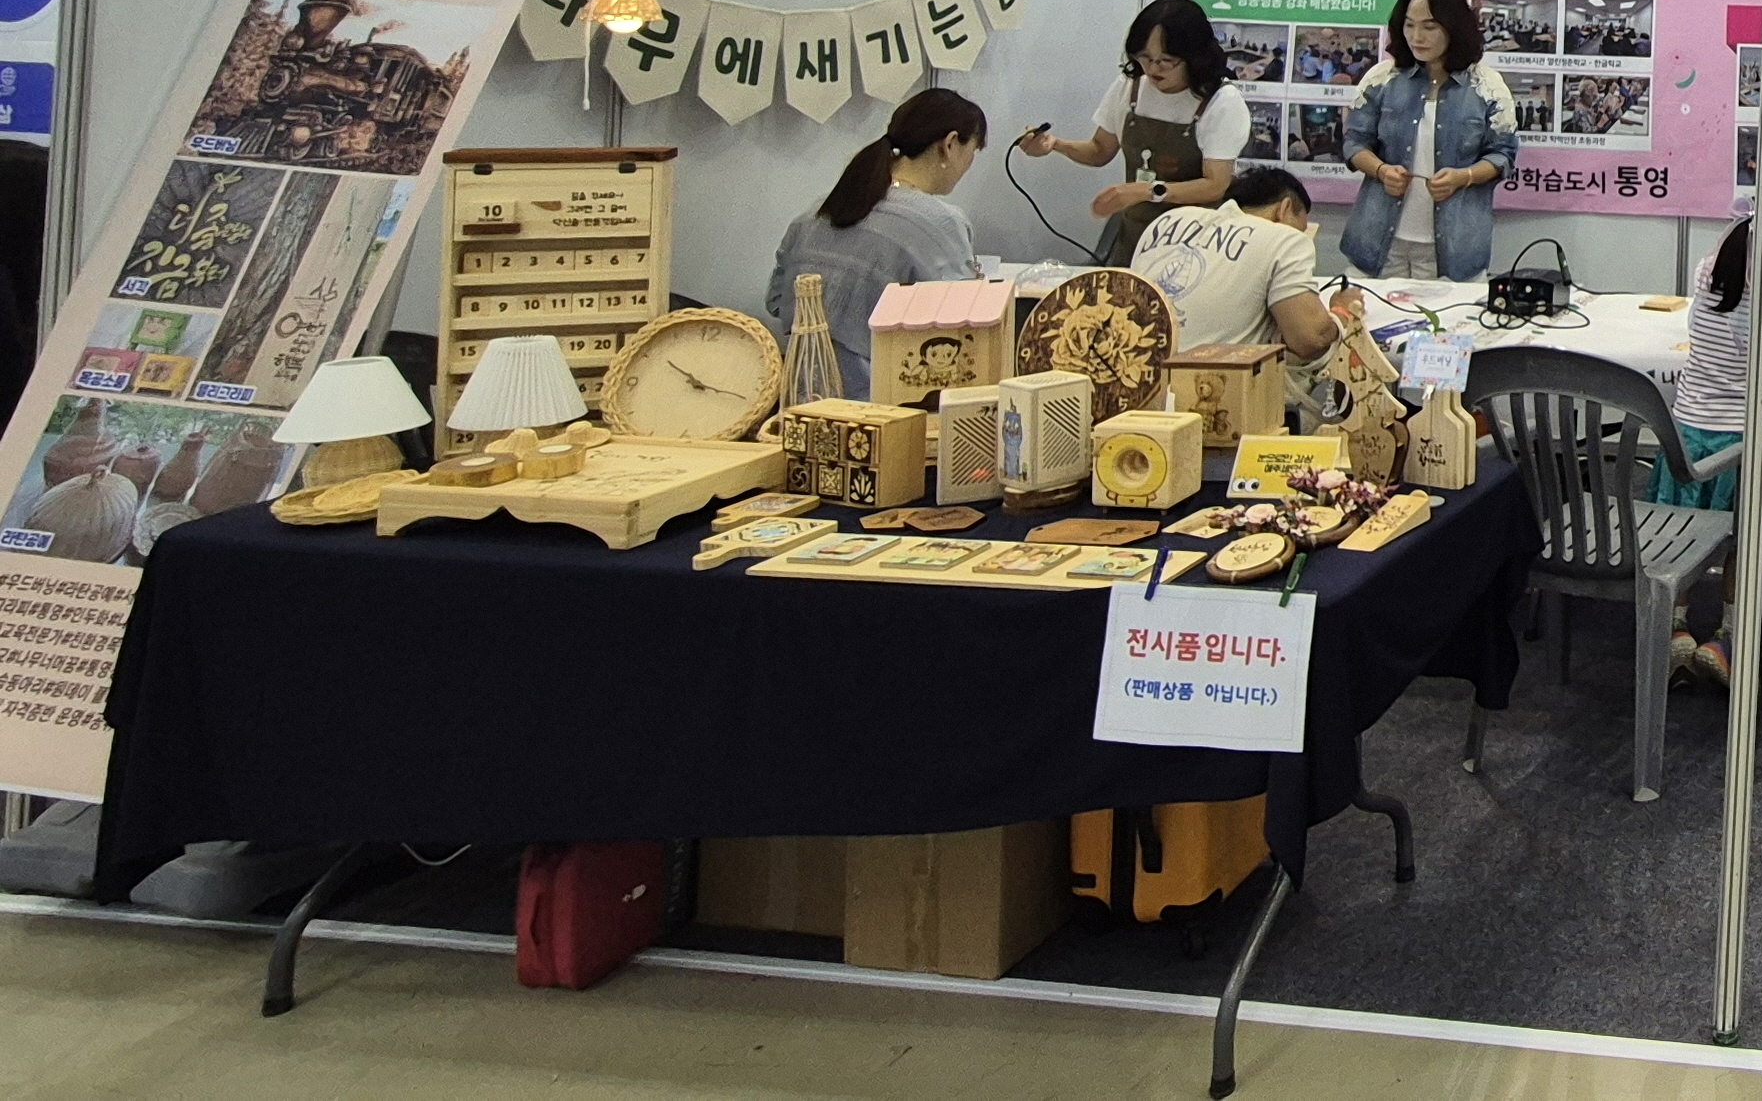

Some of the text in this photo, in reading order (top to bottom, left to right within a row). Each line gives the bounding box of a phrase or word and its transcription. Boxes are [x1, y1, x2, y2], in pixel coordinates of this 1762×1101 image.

[1613, 164, 1670, 199] 통영
[482, 205, 503, 217] 10
[474, 253, 646, 269] 1 2 3 4 5 6 7
[470, 294, 648, 313] 8 9 10 11 12 13 14
[459, 339, 612, 357] 15 19 20
[1, 528, 53, 550] 라탄공예
[1125, 628, 1287, 668] 전시품입니다.
[1124, 677, 1279, 706] (판매상품 아닙니다.)
